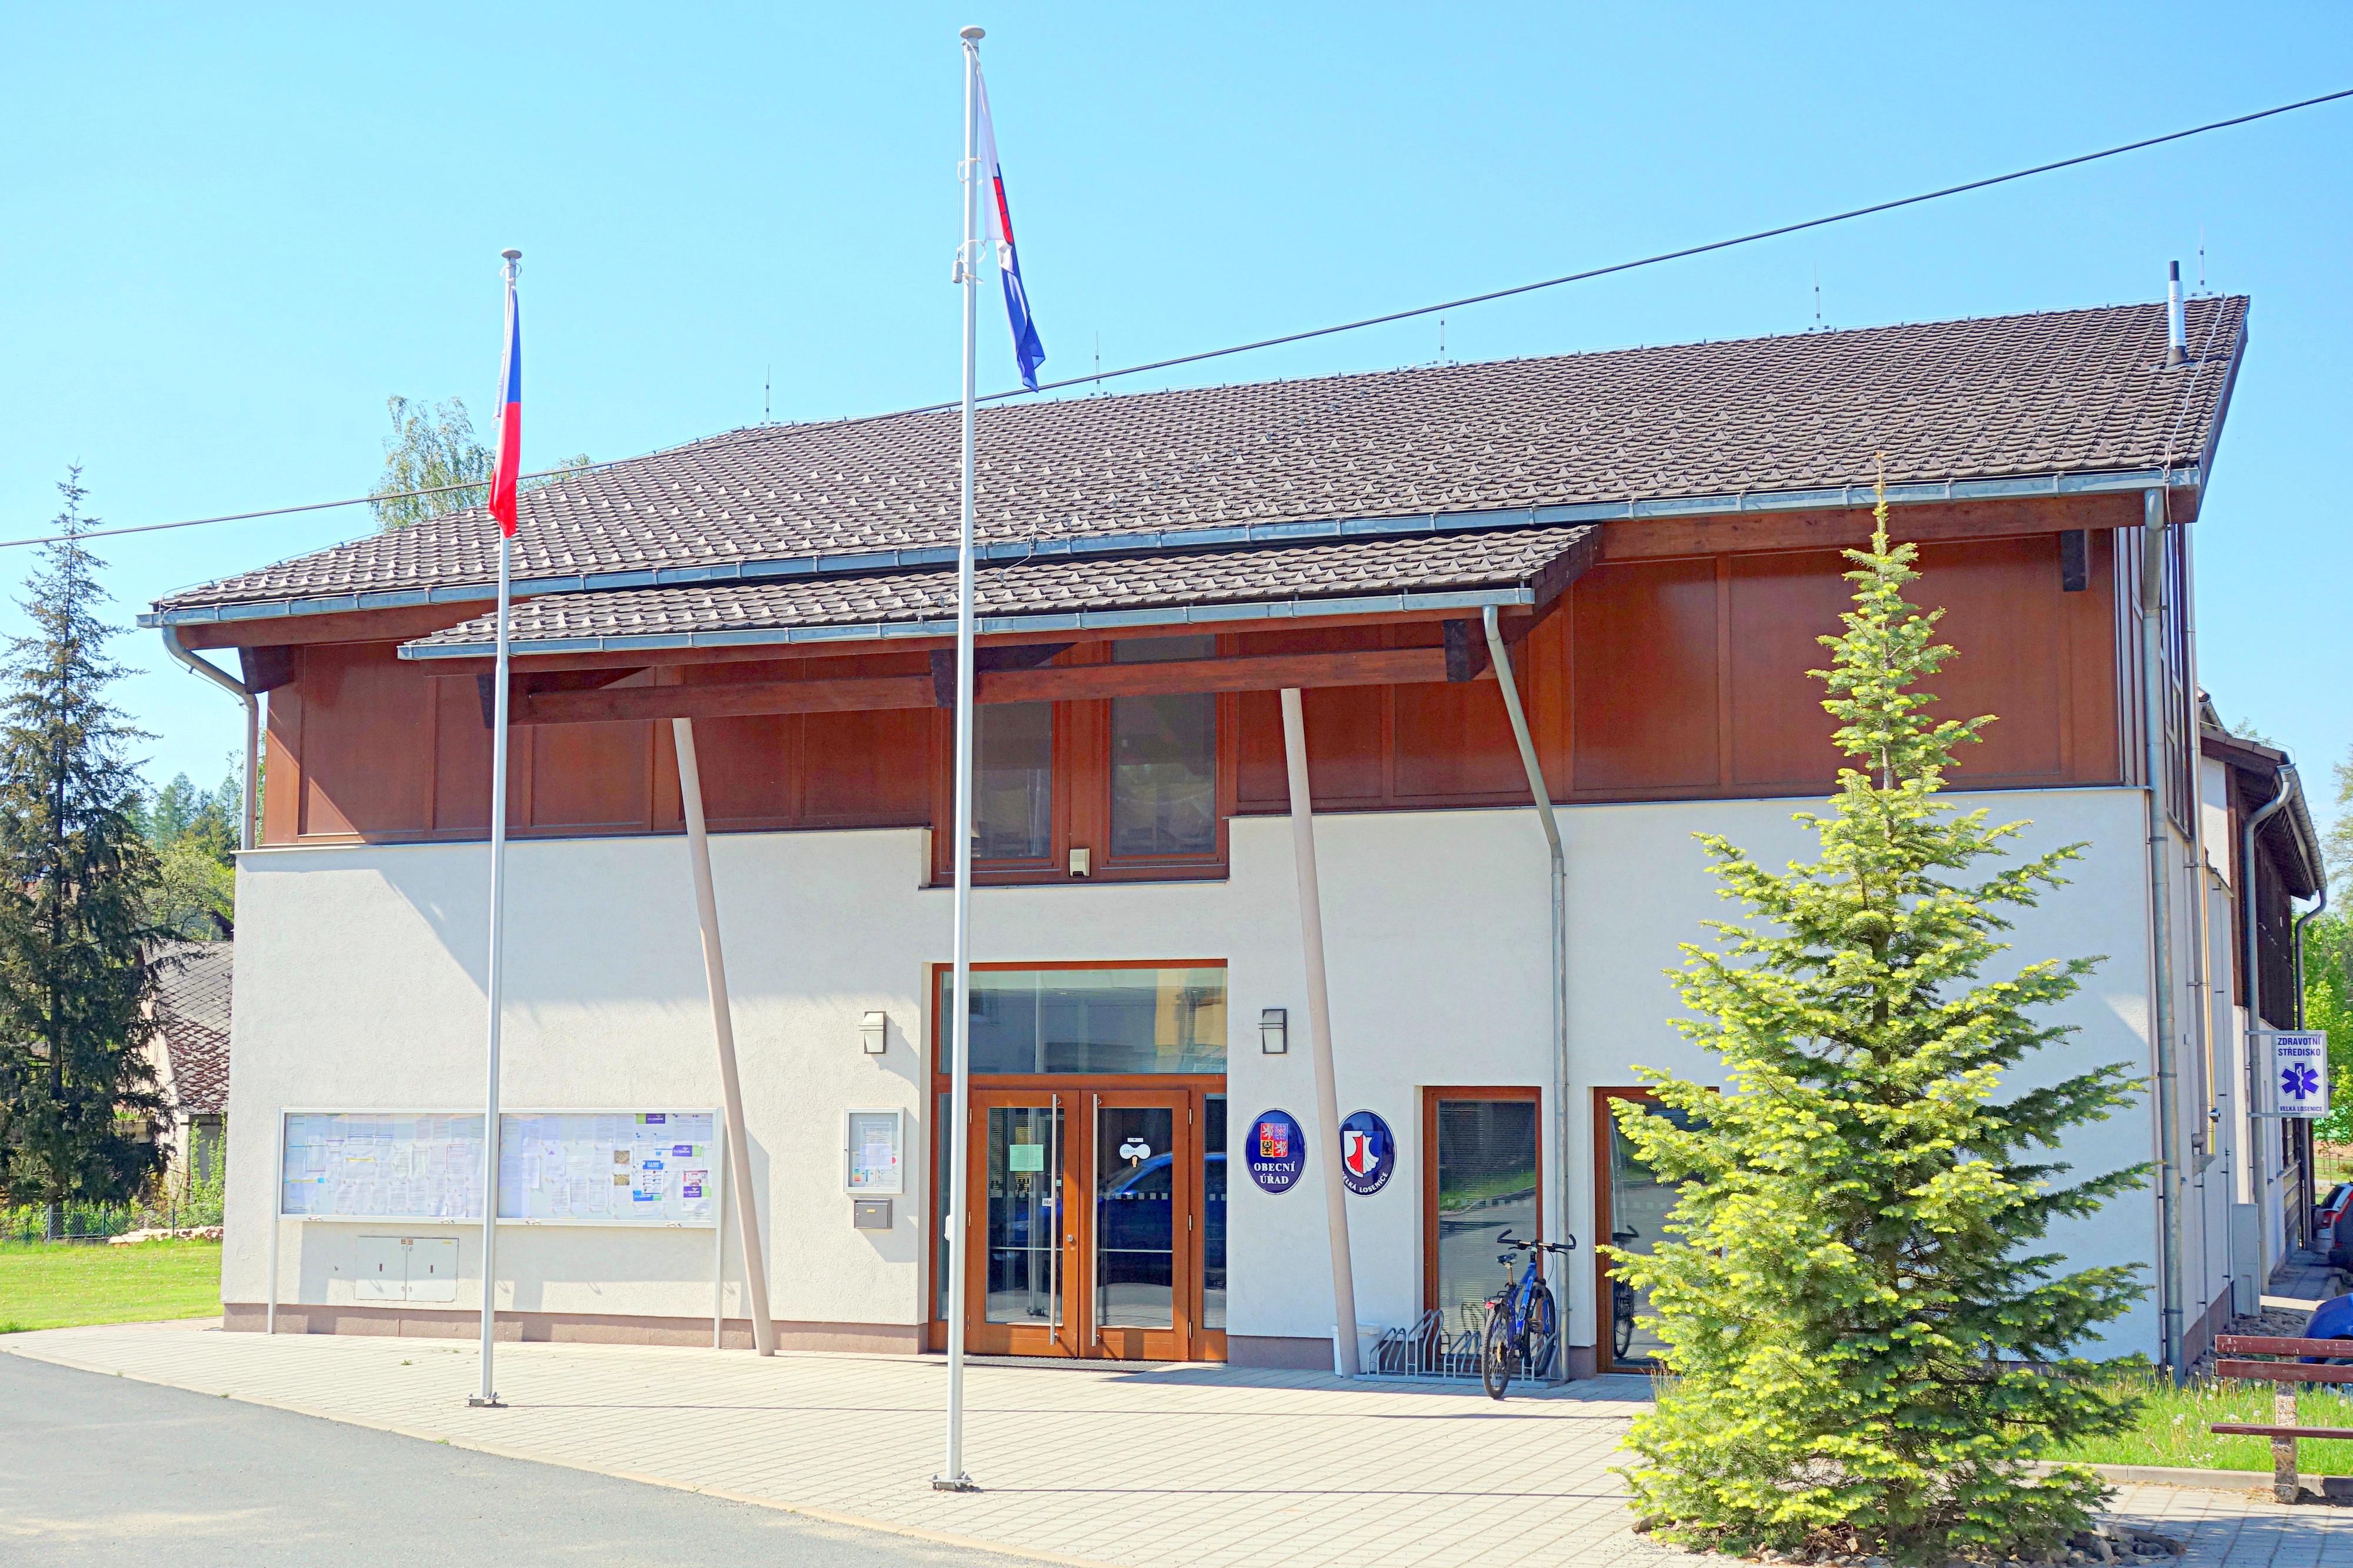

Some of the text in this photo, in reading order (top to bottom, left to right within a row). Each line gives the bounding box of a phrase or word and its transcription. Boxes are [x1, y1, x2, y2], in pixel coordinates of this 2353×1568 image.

[2278, 1036, 2321, 1045] ZDRAVOTNÍ
[2278, 1047, 2321, 1056] STŘEDISKO
[1254, 1160, 1295, 1172] OBECNÍ
[1259, 1173, 1289, 1184] ÚŘAD
[1359, 1172, 1388, 1193] LOSENICE
